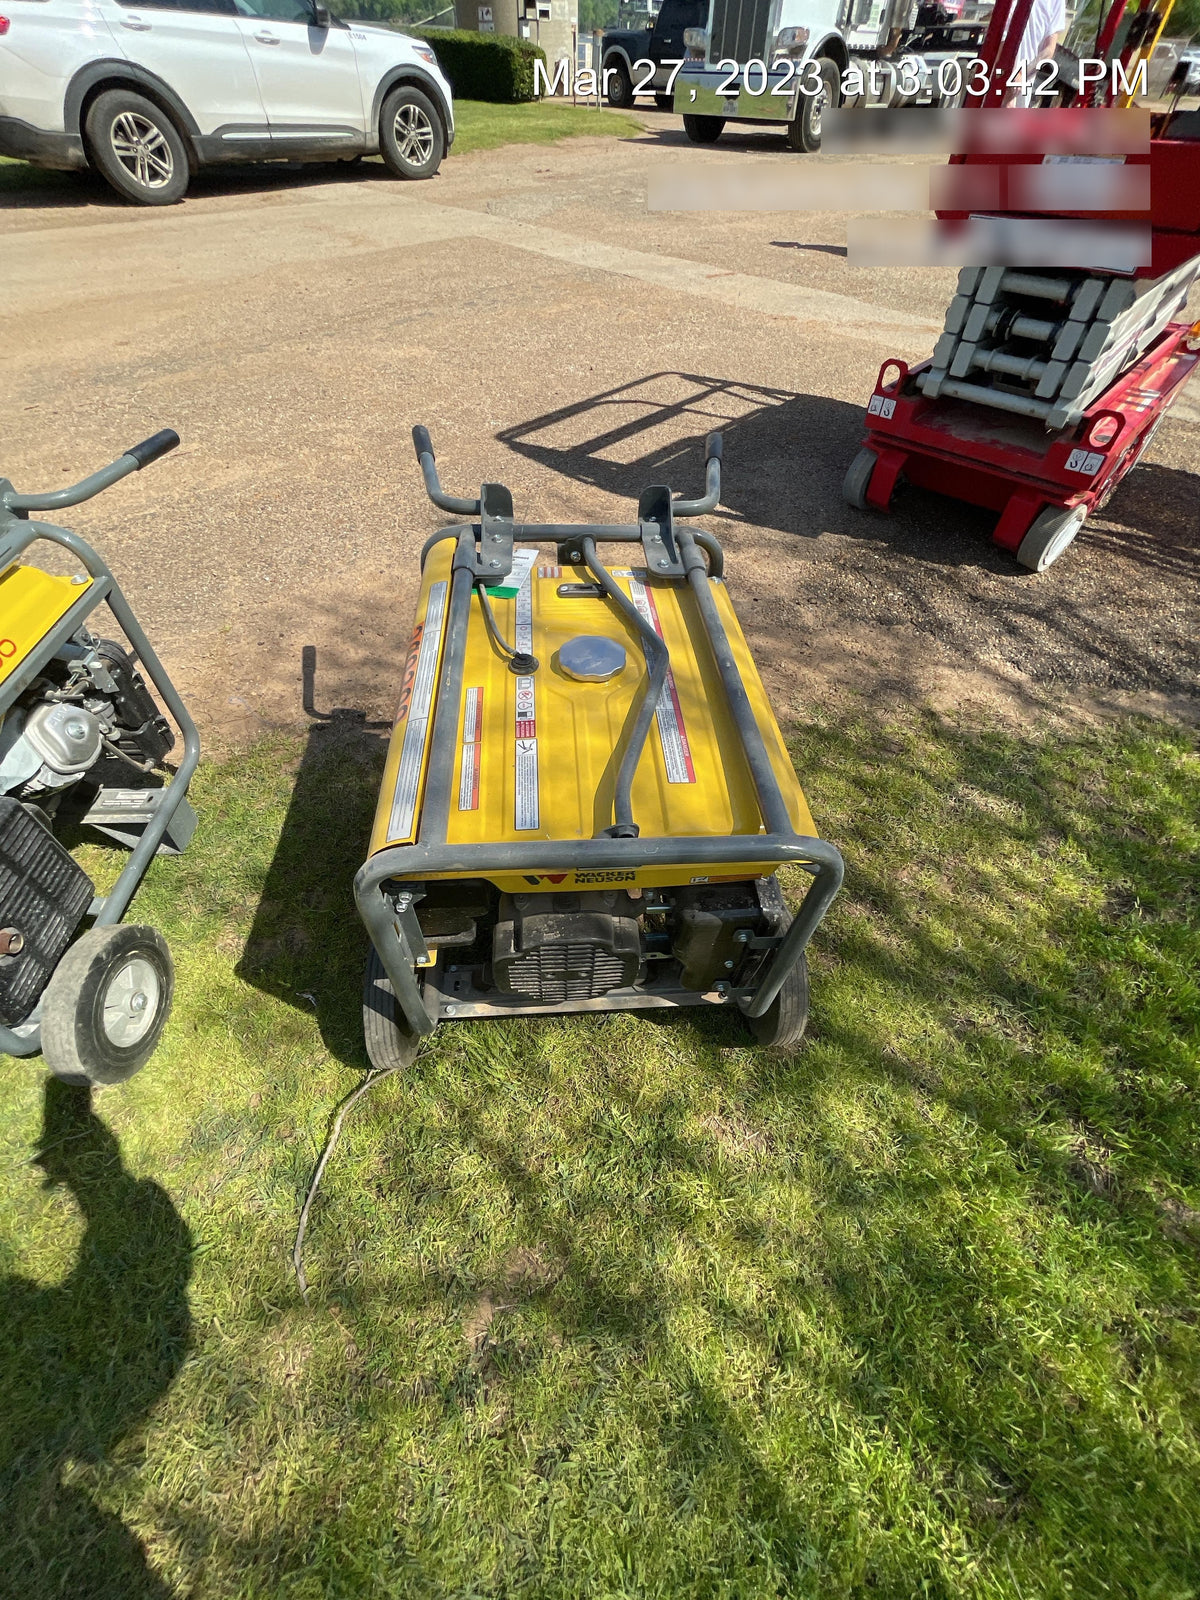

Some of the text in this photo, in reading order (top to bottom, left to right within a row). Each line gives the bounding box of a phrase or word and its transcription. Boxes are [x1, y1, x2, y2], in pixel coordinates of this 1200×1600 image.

[681, 738, 690, 757] DANGER
[574, 870, 636, 878] WACKER
[574, 875, 636, 884] NEUSON
